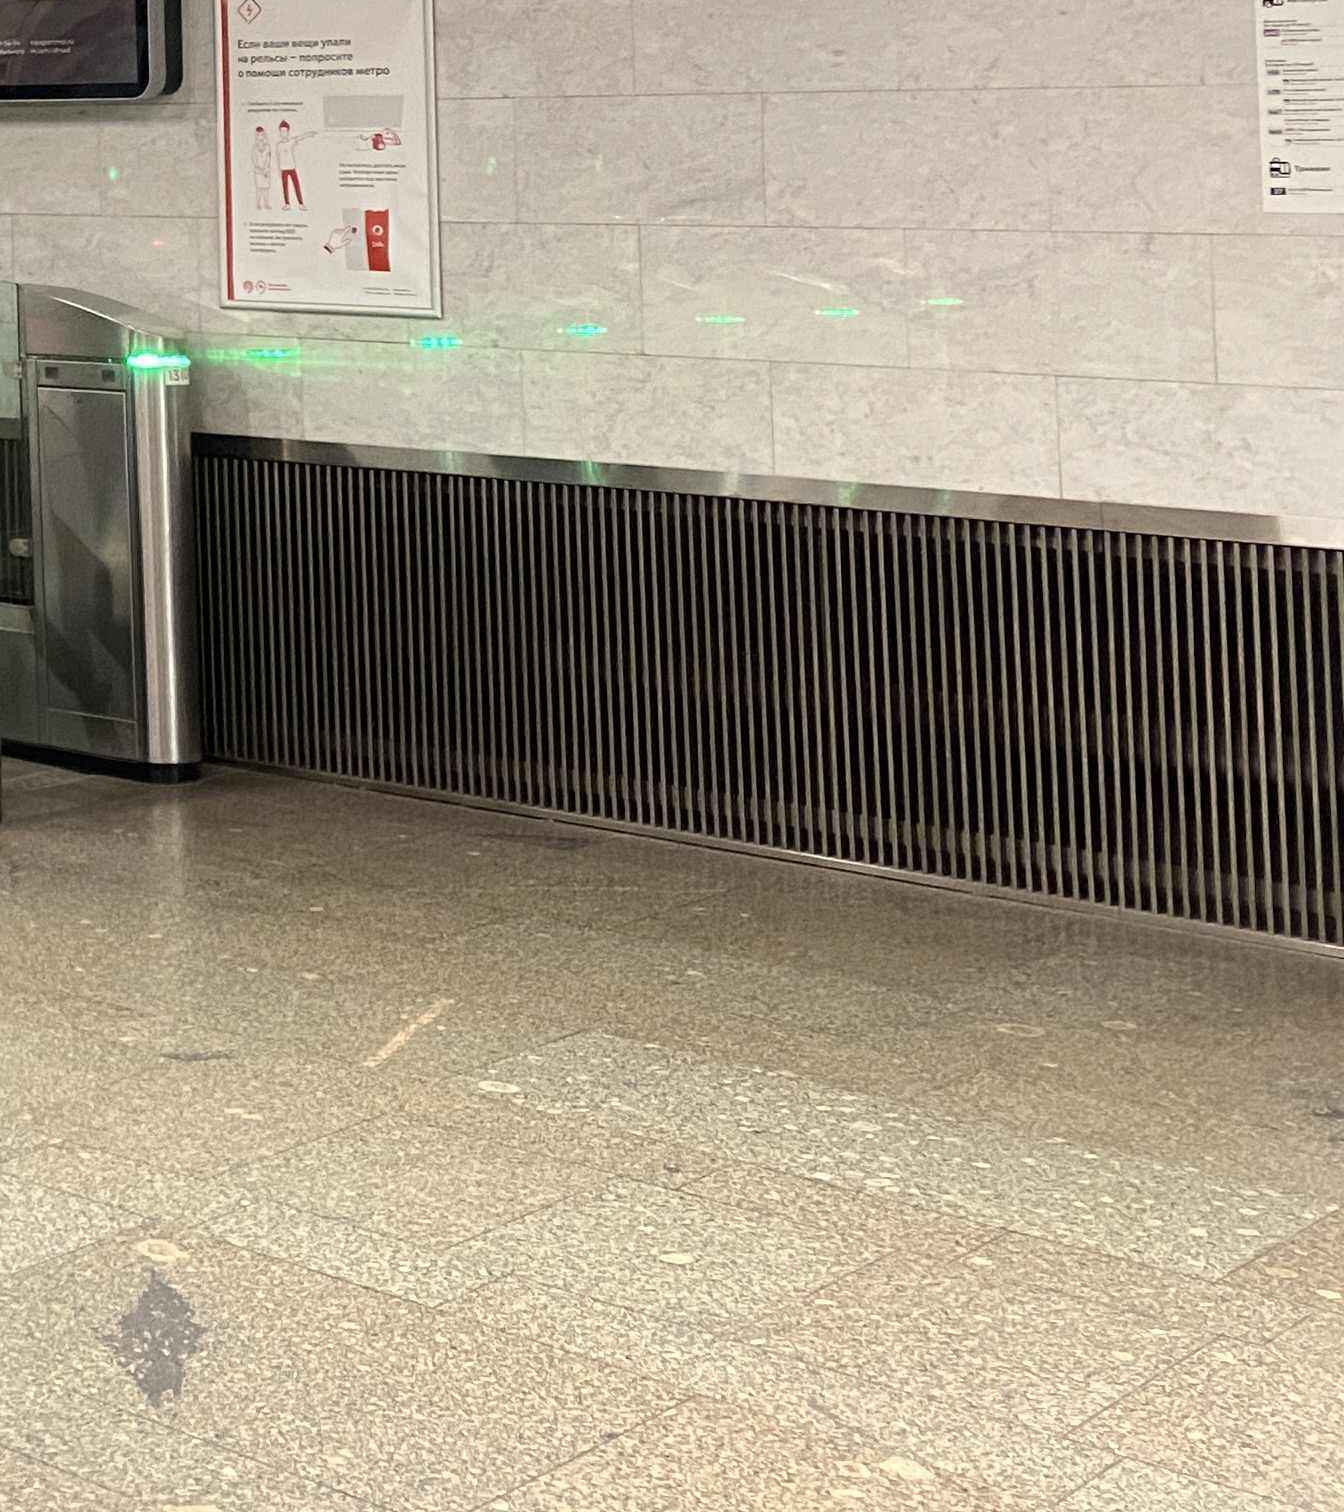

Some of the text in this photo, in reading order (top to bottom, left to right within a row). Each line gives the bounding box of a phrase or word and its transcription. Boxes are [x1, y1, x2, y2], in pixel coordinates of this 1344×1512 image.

[237, 39, 261, 49] Если
[262, 39, 290, 49] ваши
[320, 38, 351, 49] упали
[237, 55, 249, 64] на
[250, 55, 288, 65] рельсы
[299, 53, 353, 64] попросите
[287, 67, 353, 80] сотрудников
[355, 66, 391, 76] метро
